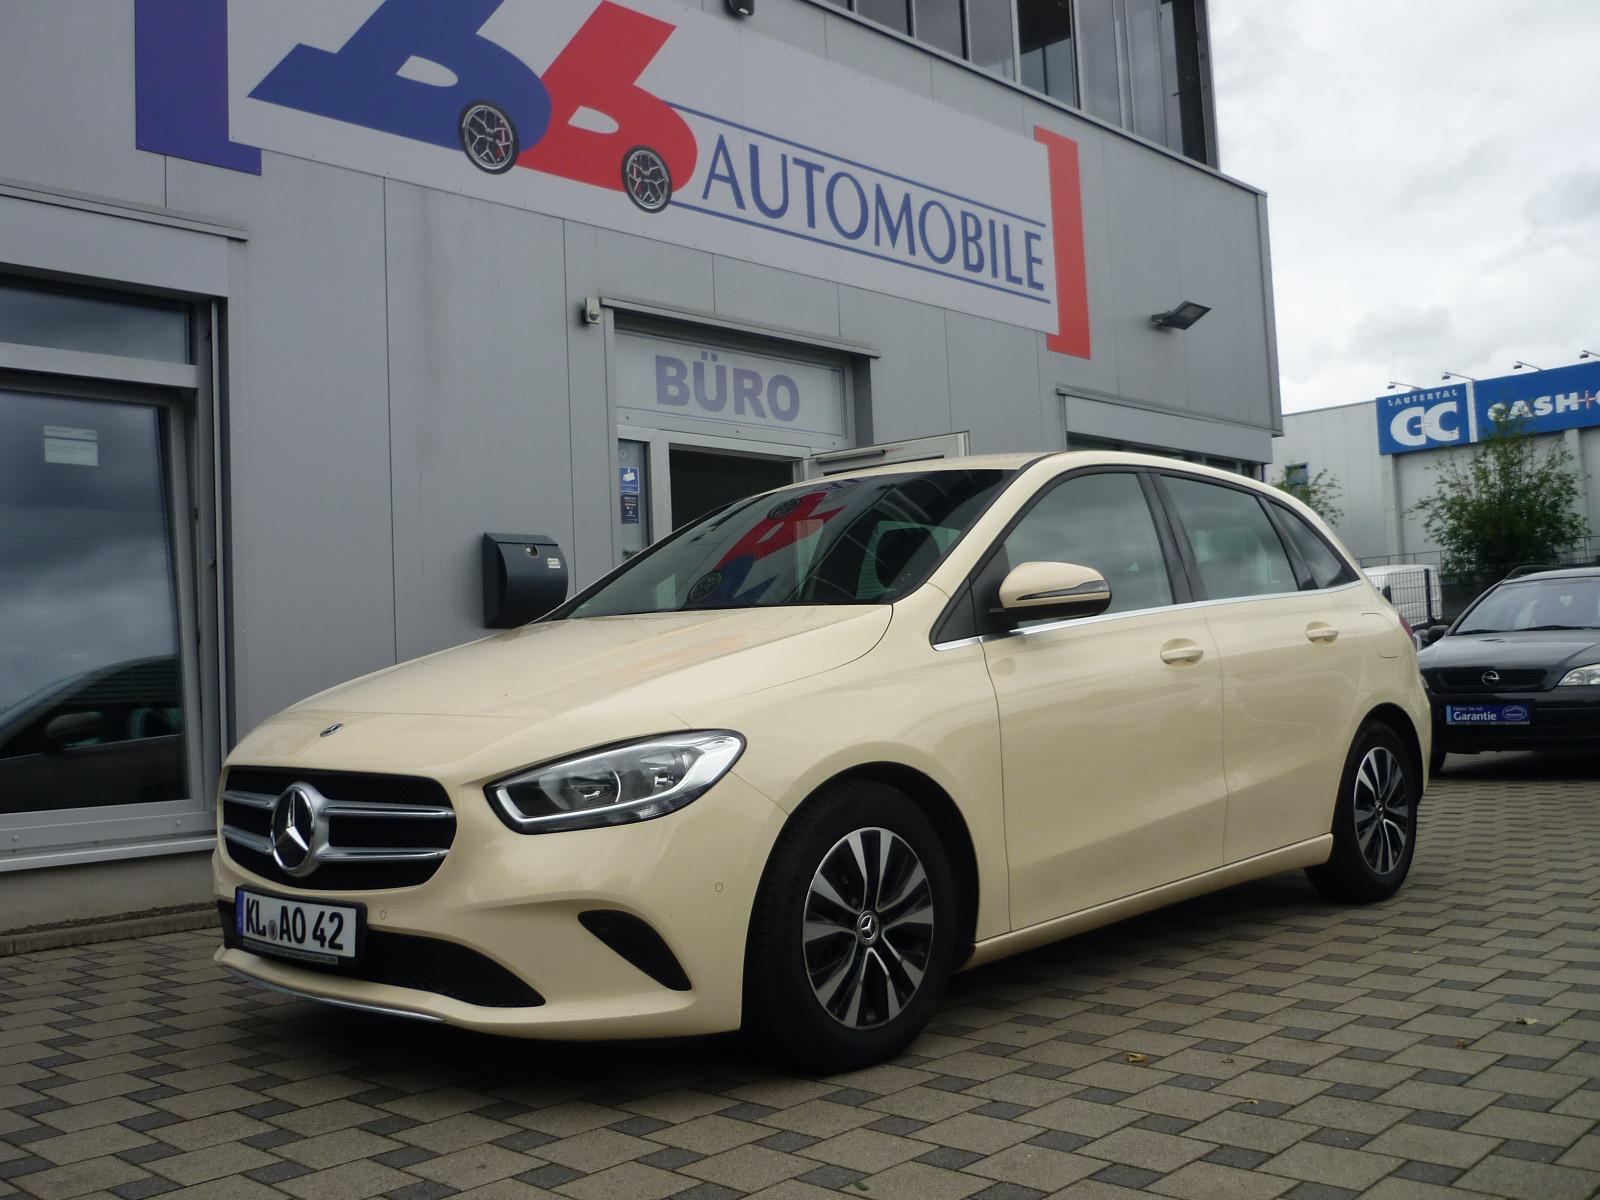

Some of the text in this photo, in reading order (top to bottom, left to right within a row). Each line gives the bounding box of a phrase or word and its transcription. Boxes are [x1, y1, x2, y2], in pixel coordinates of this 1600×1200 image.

[702, 133, 1045, 292] AUTOMOBILE
[655, 351, 801, 422] BÜRO
[1387, 388, 1458, 407] LAUTERTAL
[1453, 710, 1497, 721] Garantie
[245, 897, 344, 951] KL AO 42
